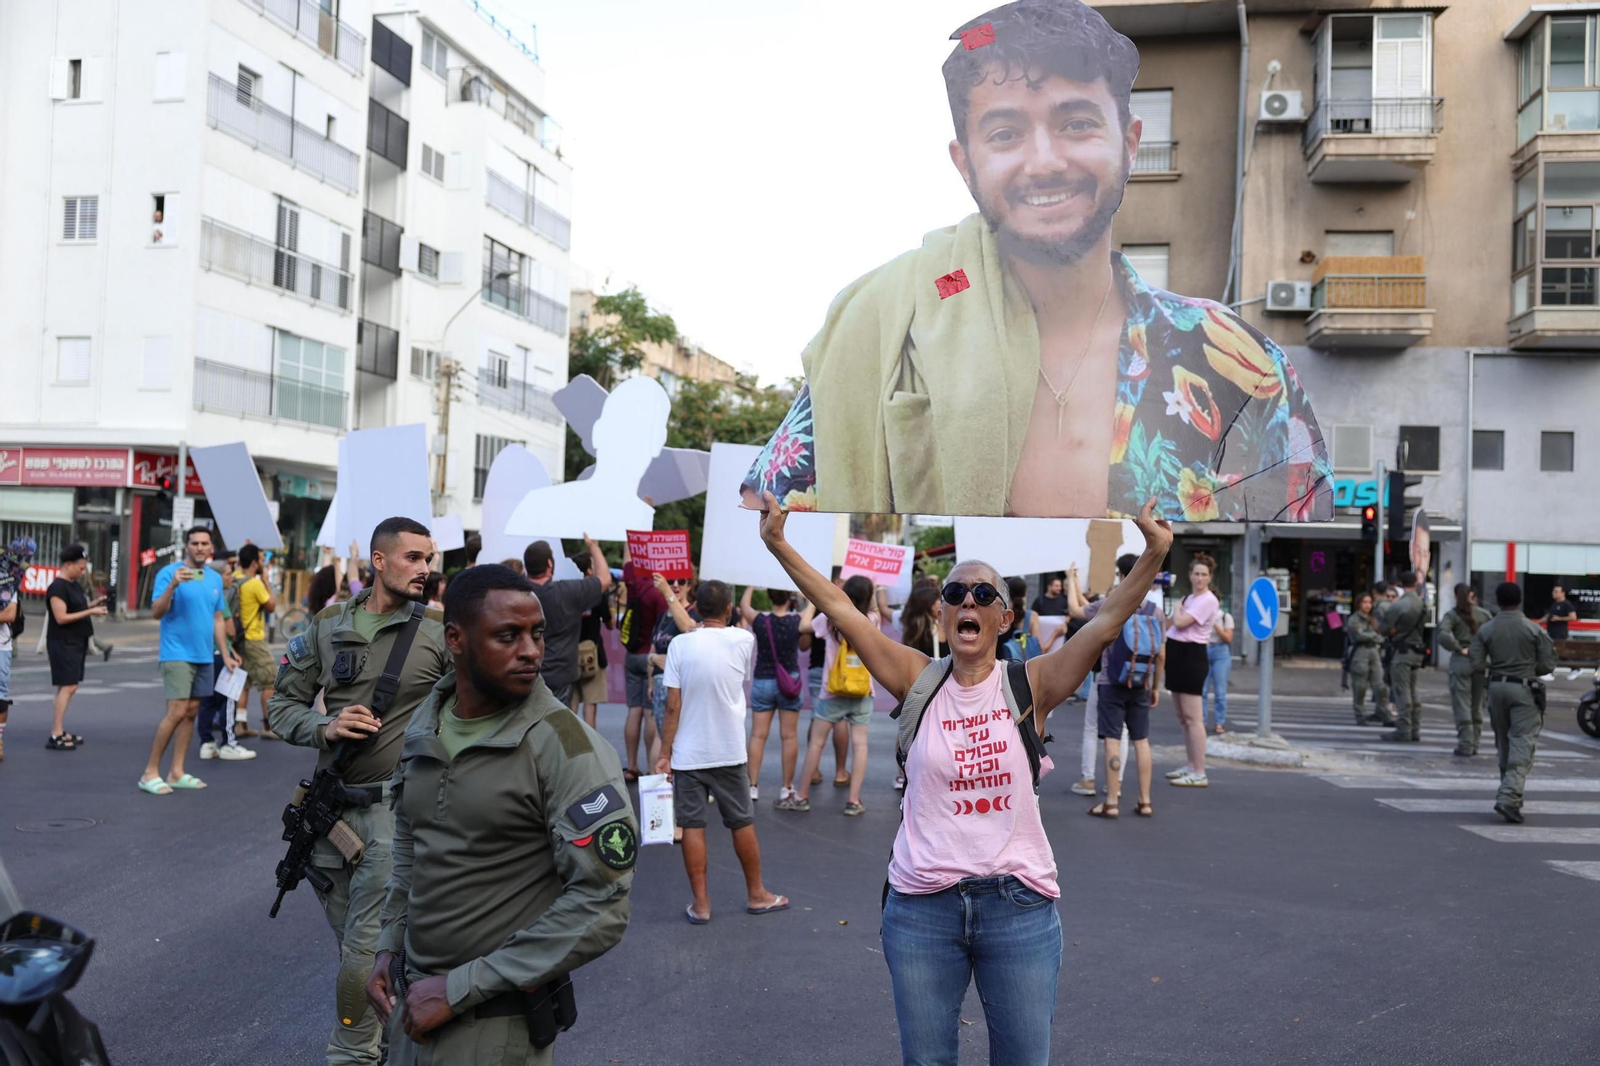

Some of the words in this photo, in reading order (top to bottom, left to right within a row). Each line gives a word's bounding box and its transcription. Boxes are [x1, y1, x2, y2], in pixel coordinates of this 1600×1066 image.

[628, 532, 651, 542] ישראל
[652, 533, 686, 542] ממשלת
[629, 543, 647, 556] את
[652, 546, 683, 555] הורגת
[888, 548, 906, 559] קול
[632, 557, 689, 571] החטופים
[873, 559, 900, 571] זועק
[992, 708, 1011, 721] לא
[942, 713, 989, 732] עוצרות
[968, 727, 990, 744] עד
[954, 740, 1008, 762] שכולם
[958, 758, 1000, 779] וכולן
[949, 772, 1011, 792] חוזרות!
